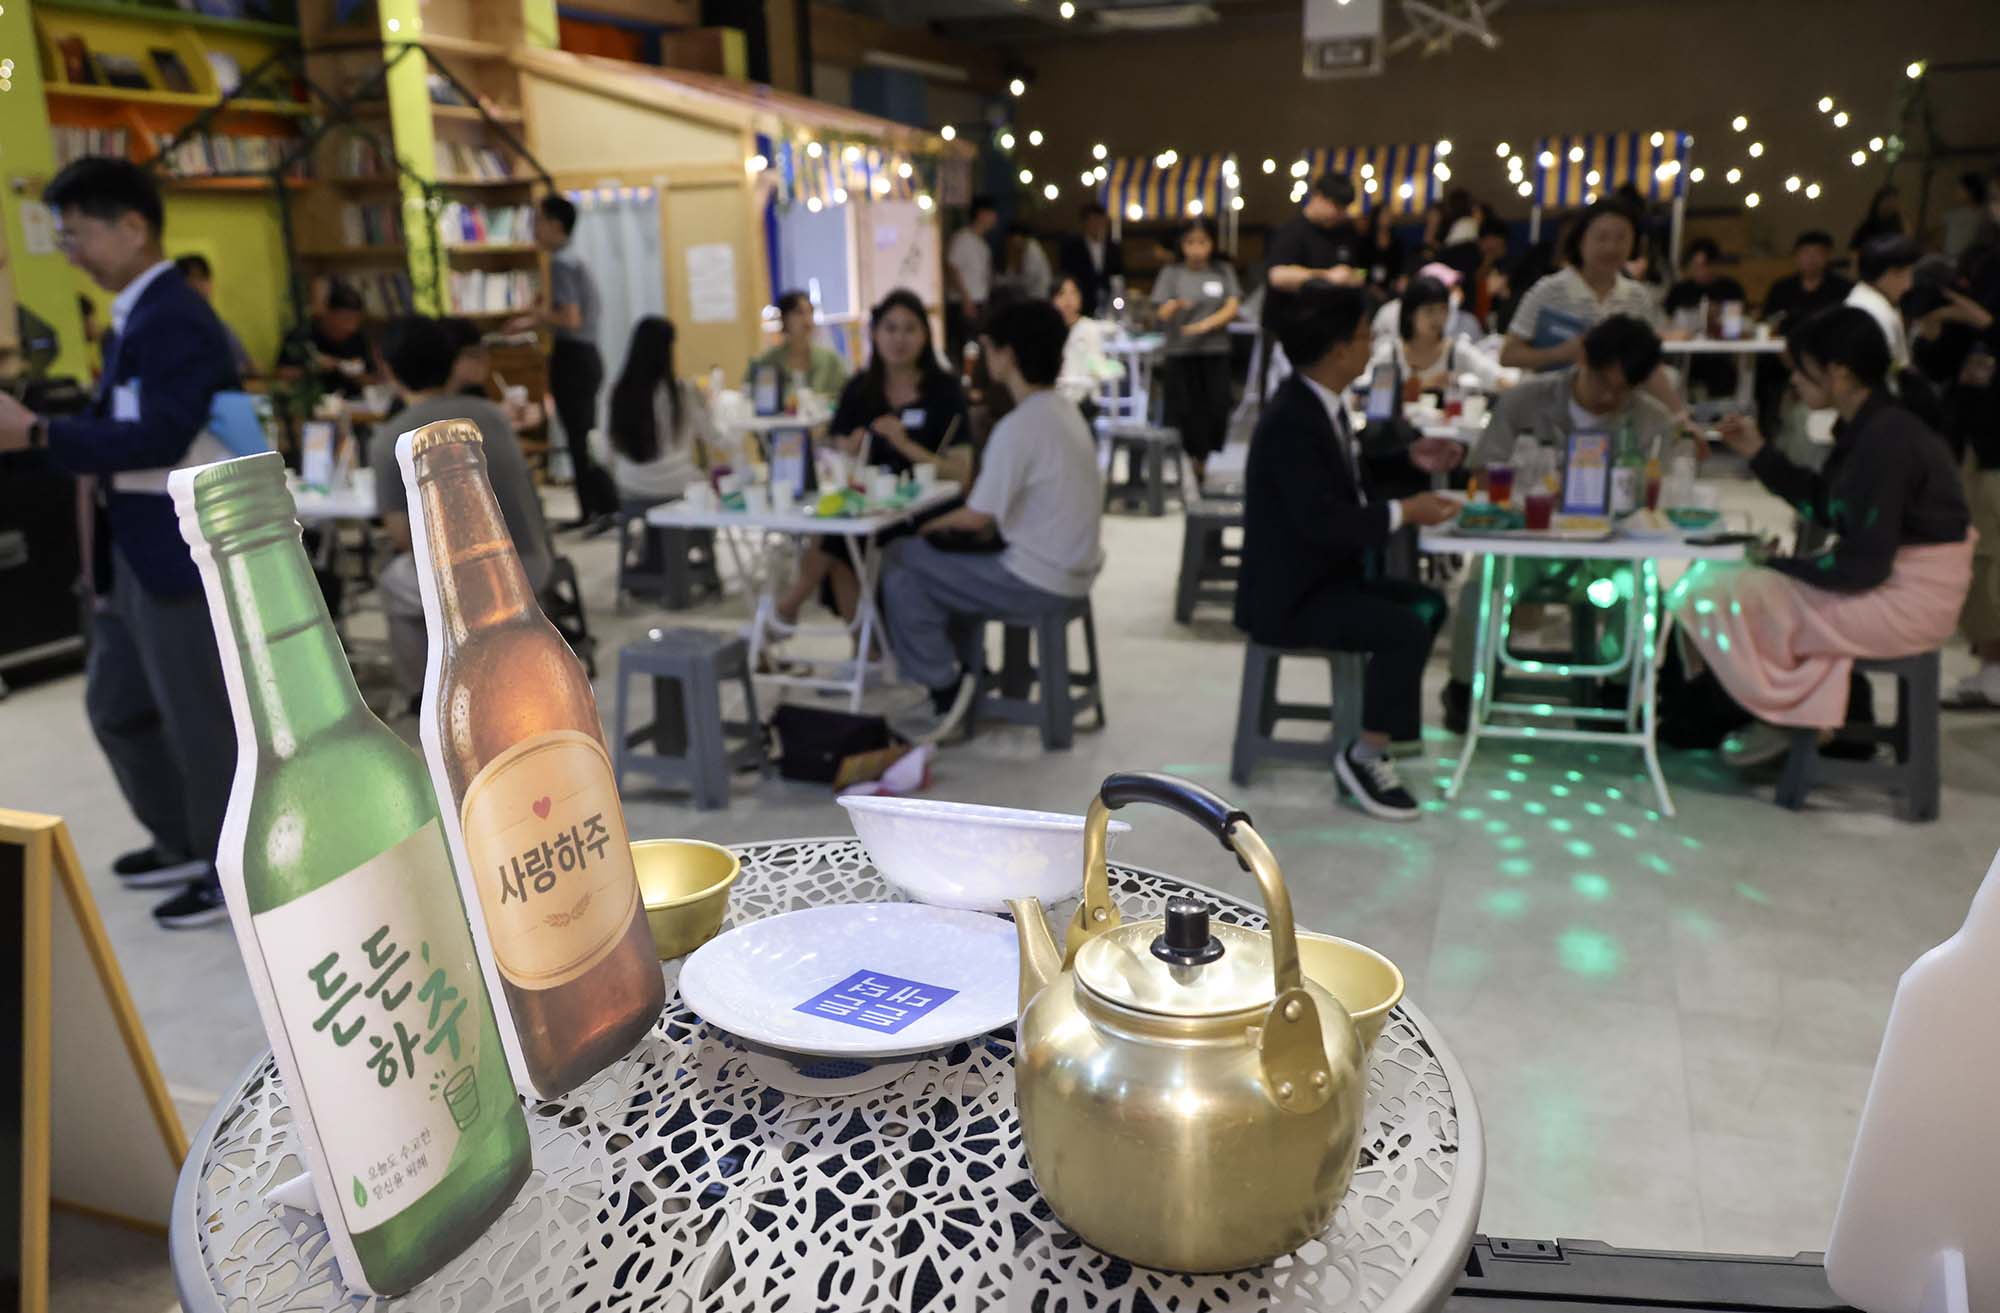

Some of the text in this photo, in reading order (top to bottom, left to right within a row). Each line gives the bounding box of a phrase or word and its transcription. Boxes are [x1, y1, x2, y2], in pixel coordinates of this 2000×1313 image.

[499, 812, 610, 904] 사랑하주
[308, 925, 413, 1046] 든든
[368, 1153, 396, 1180] 오늘도
[372, 1172, 403, 1201] 당신을
